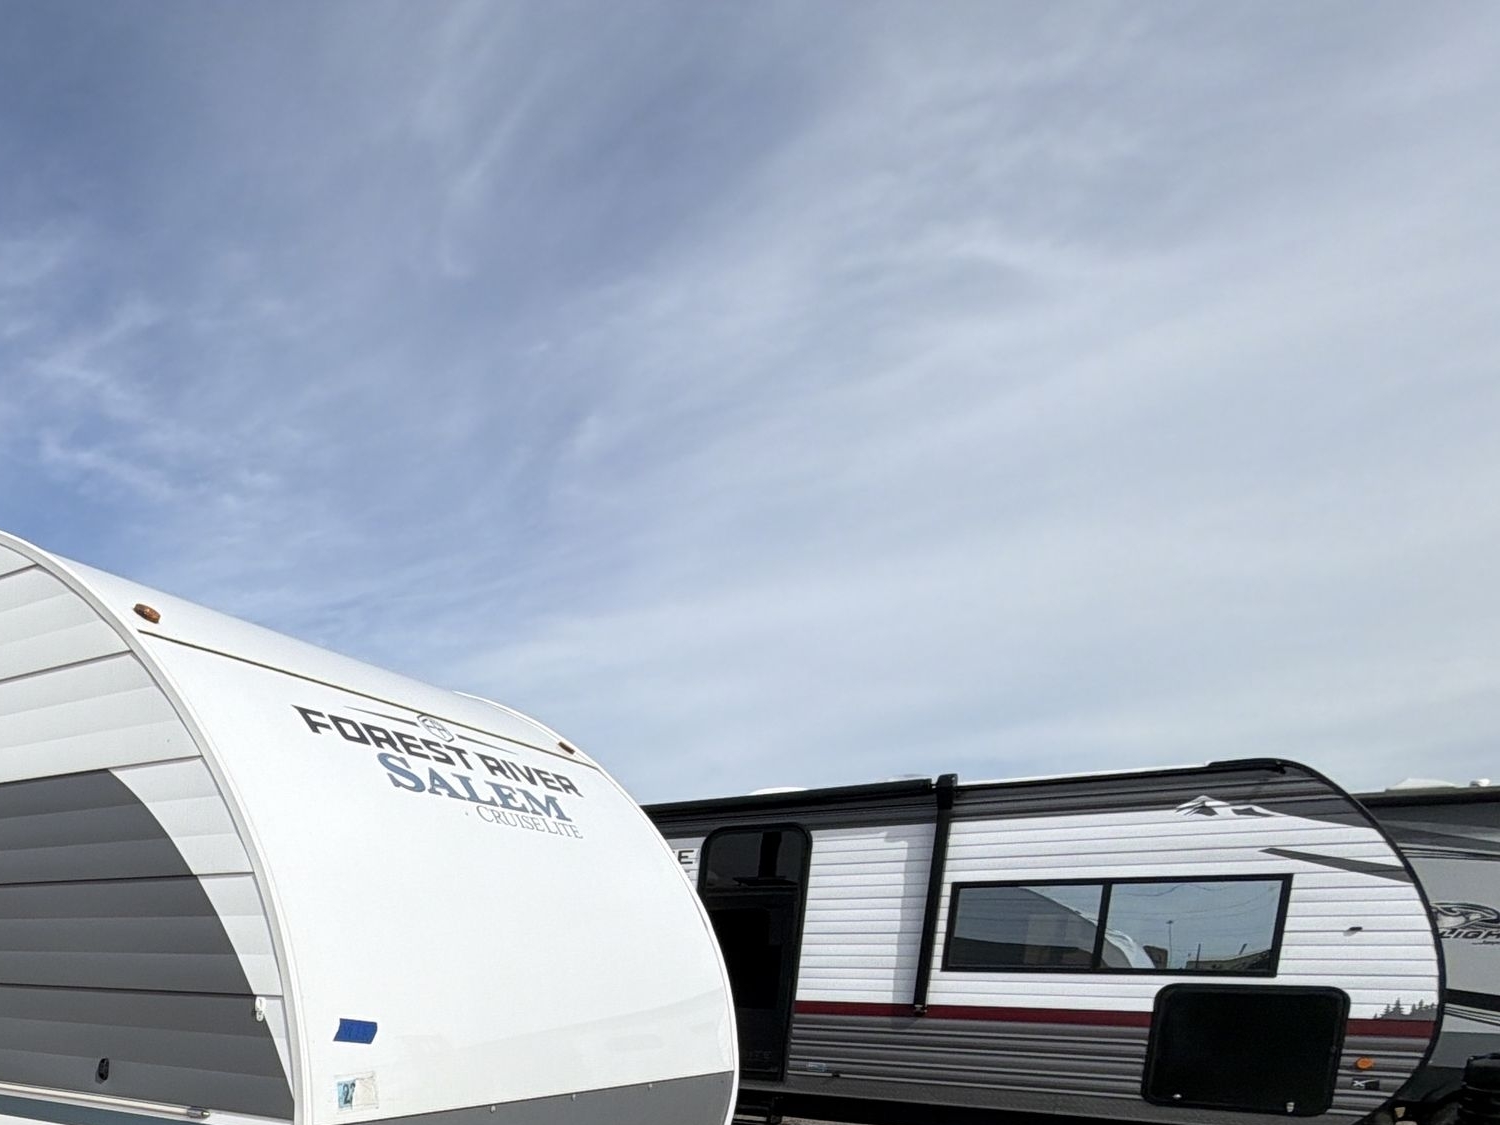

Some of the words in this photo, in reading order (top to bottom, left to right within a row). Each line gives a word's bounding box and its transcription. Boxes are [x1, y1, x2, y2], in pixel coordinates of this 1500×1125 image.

[291, 704, 473, 771] FOREST
[473, 751, 584, 798] RIVER
[377, 752, 573, 823] SALEM
[476, 805, 584, 839] CRUISELITE
